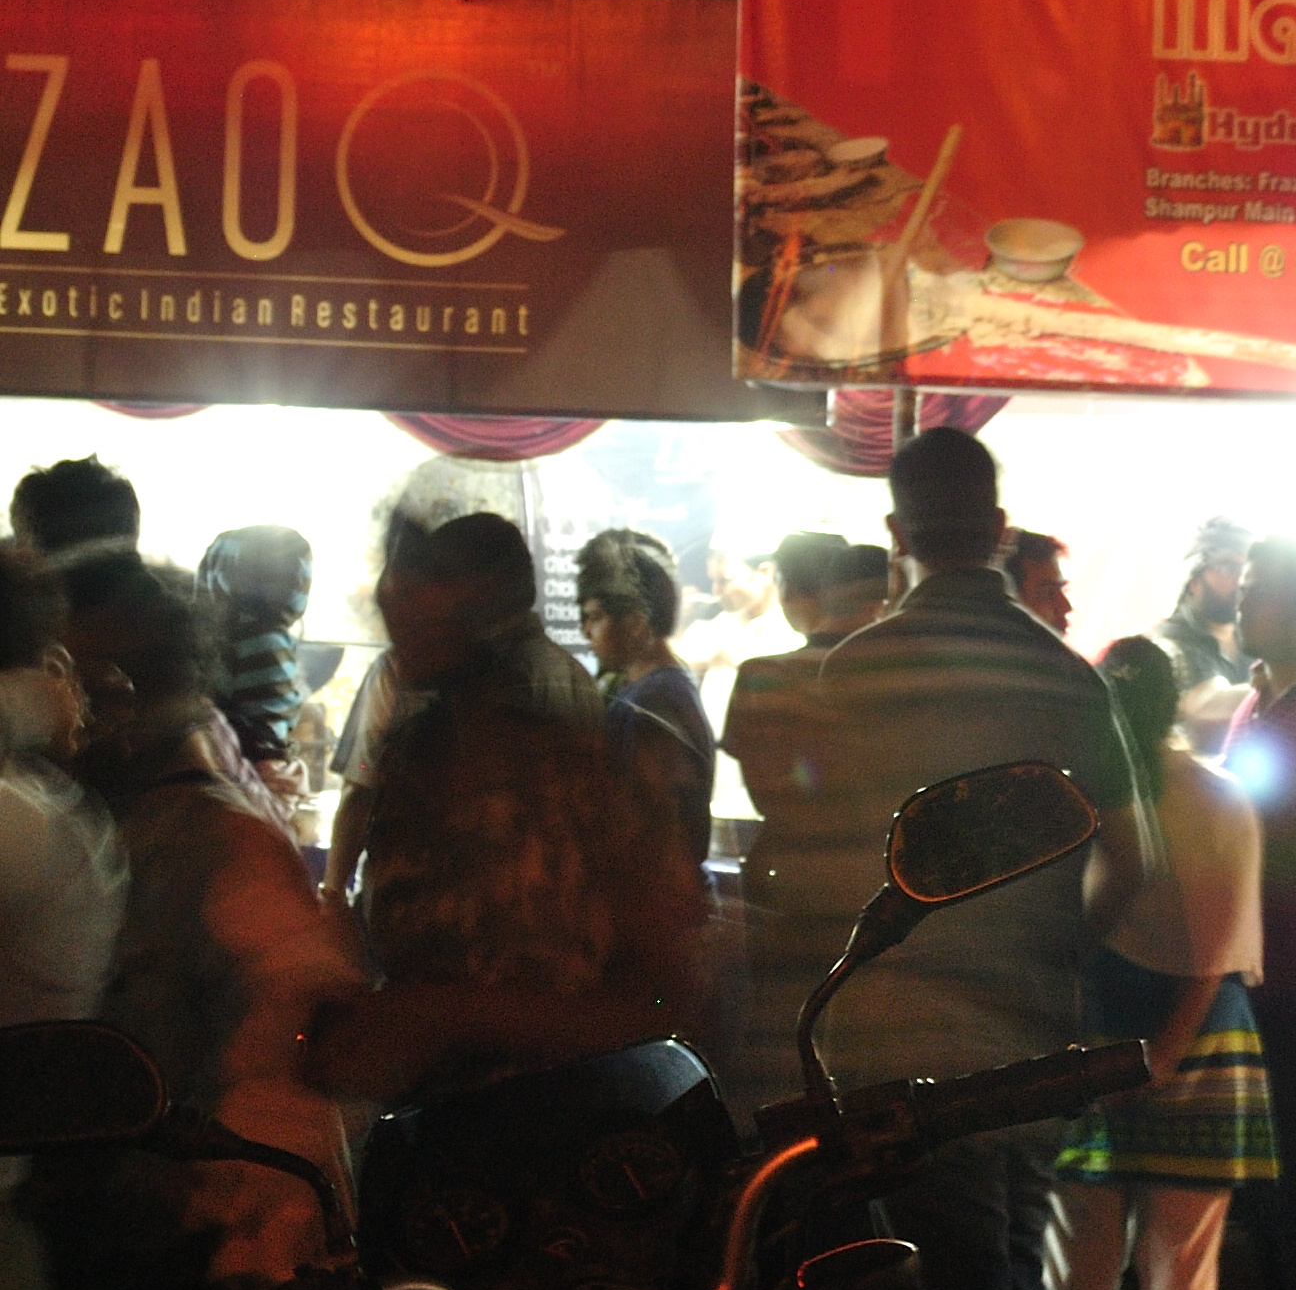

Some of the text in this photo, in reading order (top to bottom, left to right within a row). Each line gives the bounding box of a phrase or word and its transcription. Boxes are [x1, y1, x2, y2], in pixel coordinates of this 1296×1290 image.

[1145, 167, 1250, 192] Branches:
[1144, 197, 1240, 225] Shampur
[1244, 200, 1296, 222] Main
[1180, 242, 1249, 273] Call
[140, 288, 273, 325] Indian
[291, 294, 528, 335] Restaurant
